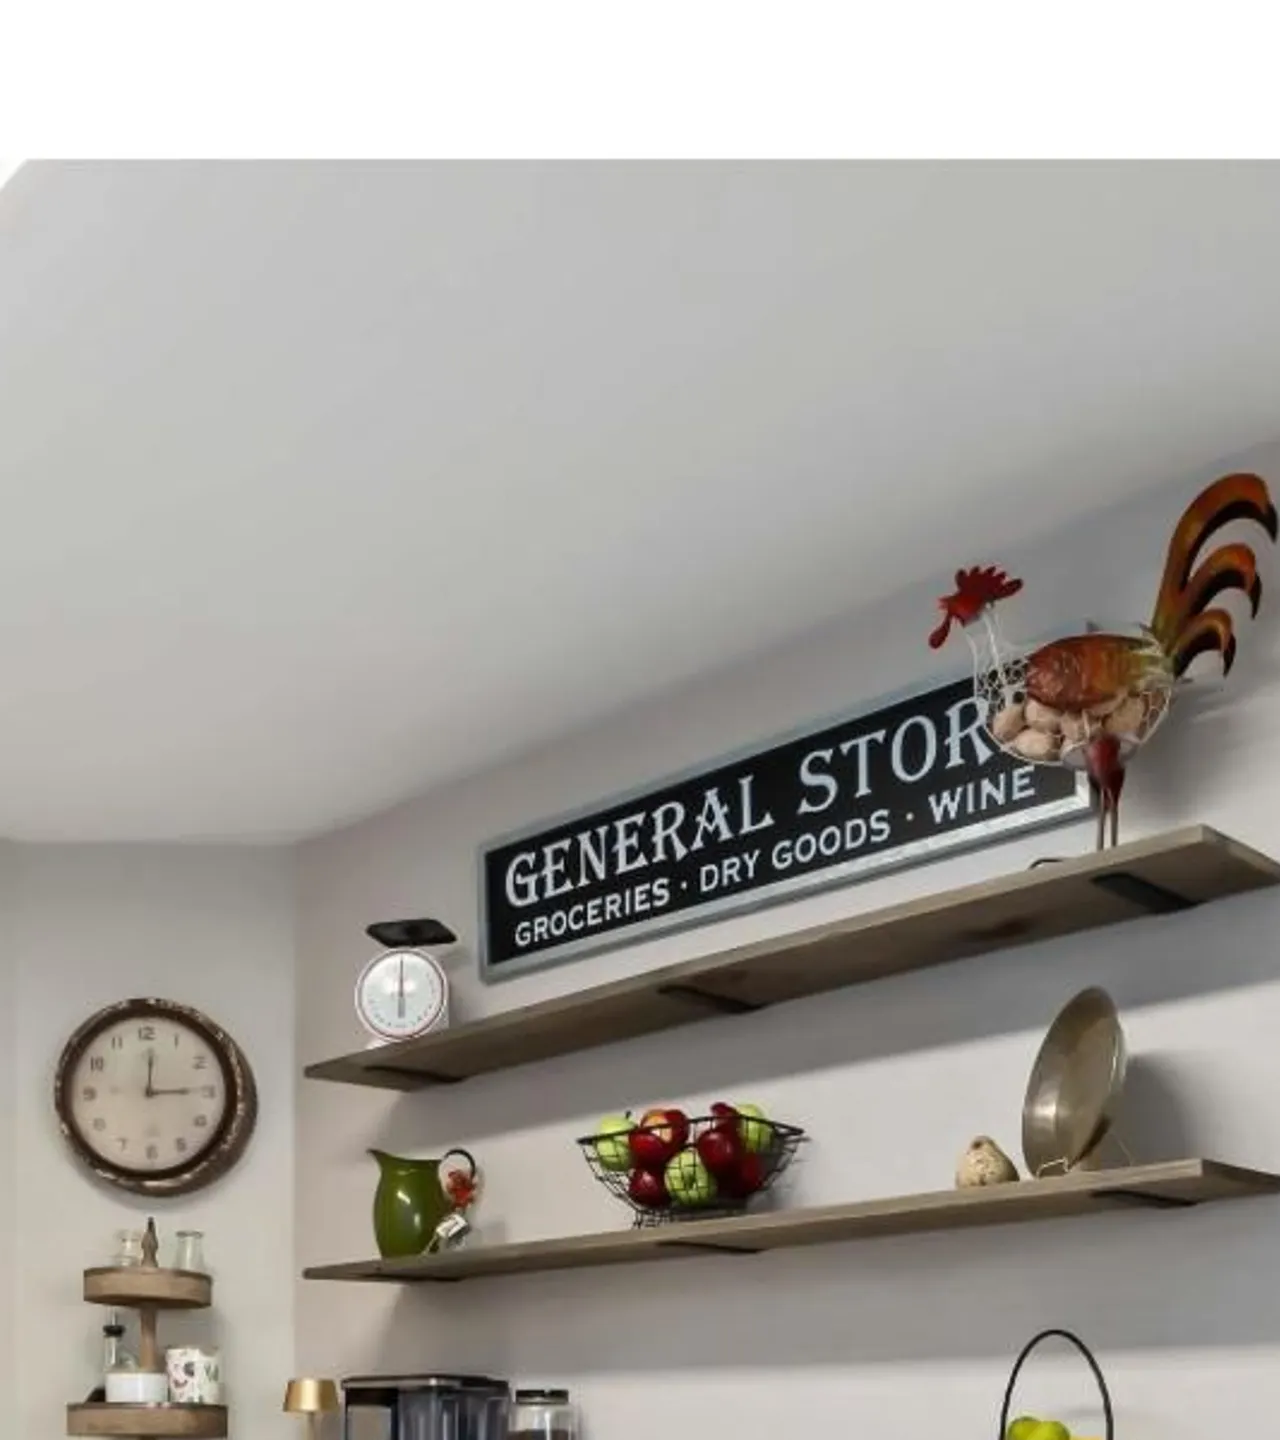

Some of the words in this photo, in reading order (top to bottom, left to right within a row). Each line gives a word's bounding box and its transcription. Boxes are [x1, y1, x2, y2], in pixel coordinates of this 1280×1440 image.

[505, 775, 775, 907] GENERAL
[797, 696, 995, 815] STOR
[515, 877, 670, 947] GROCERIES
[700, 849, 760, 892] DRY
[771, 808, 891, 870] GOODS
[927, 765, 1036, 824] WINE
